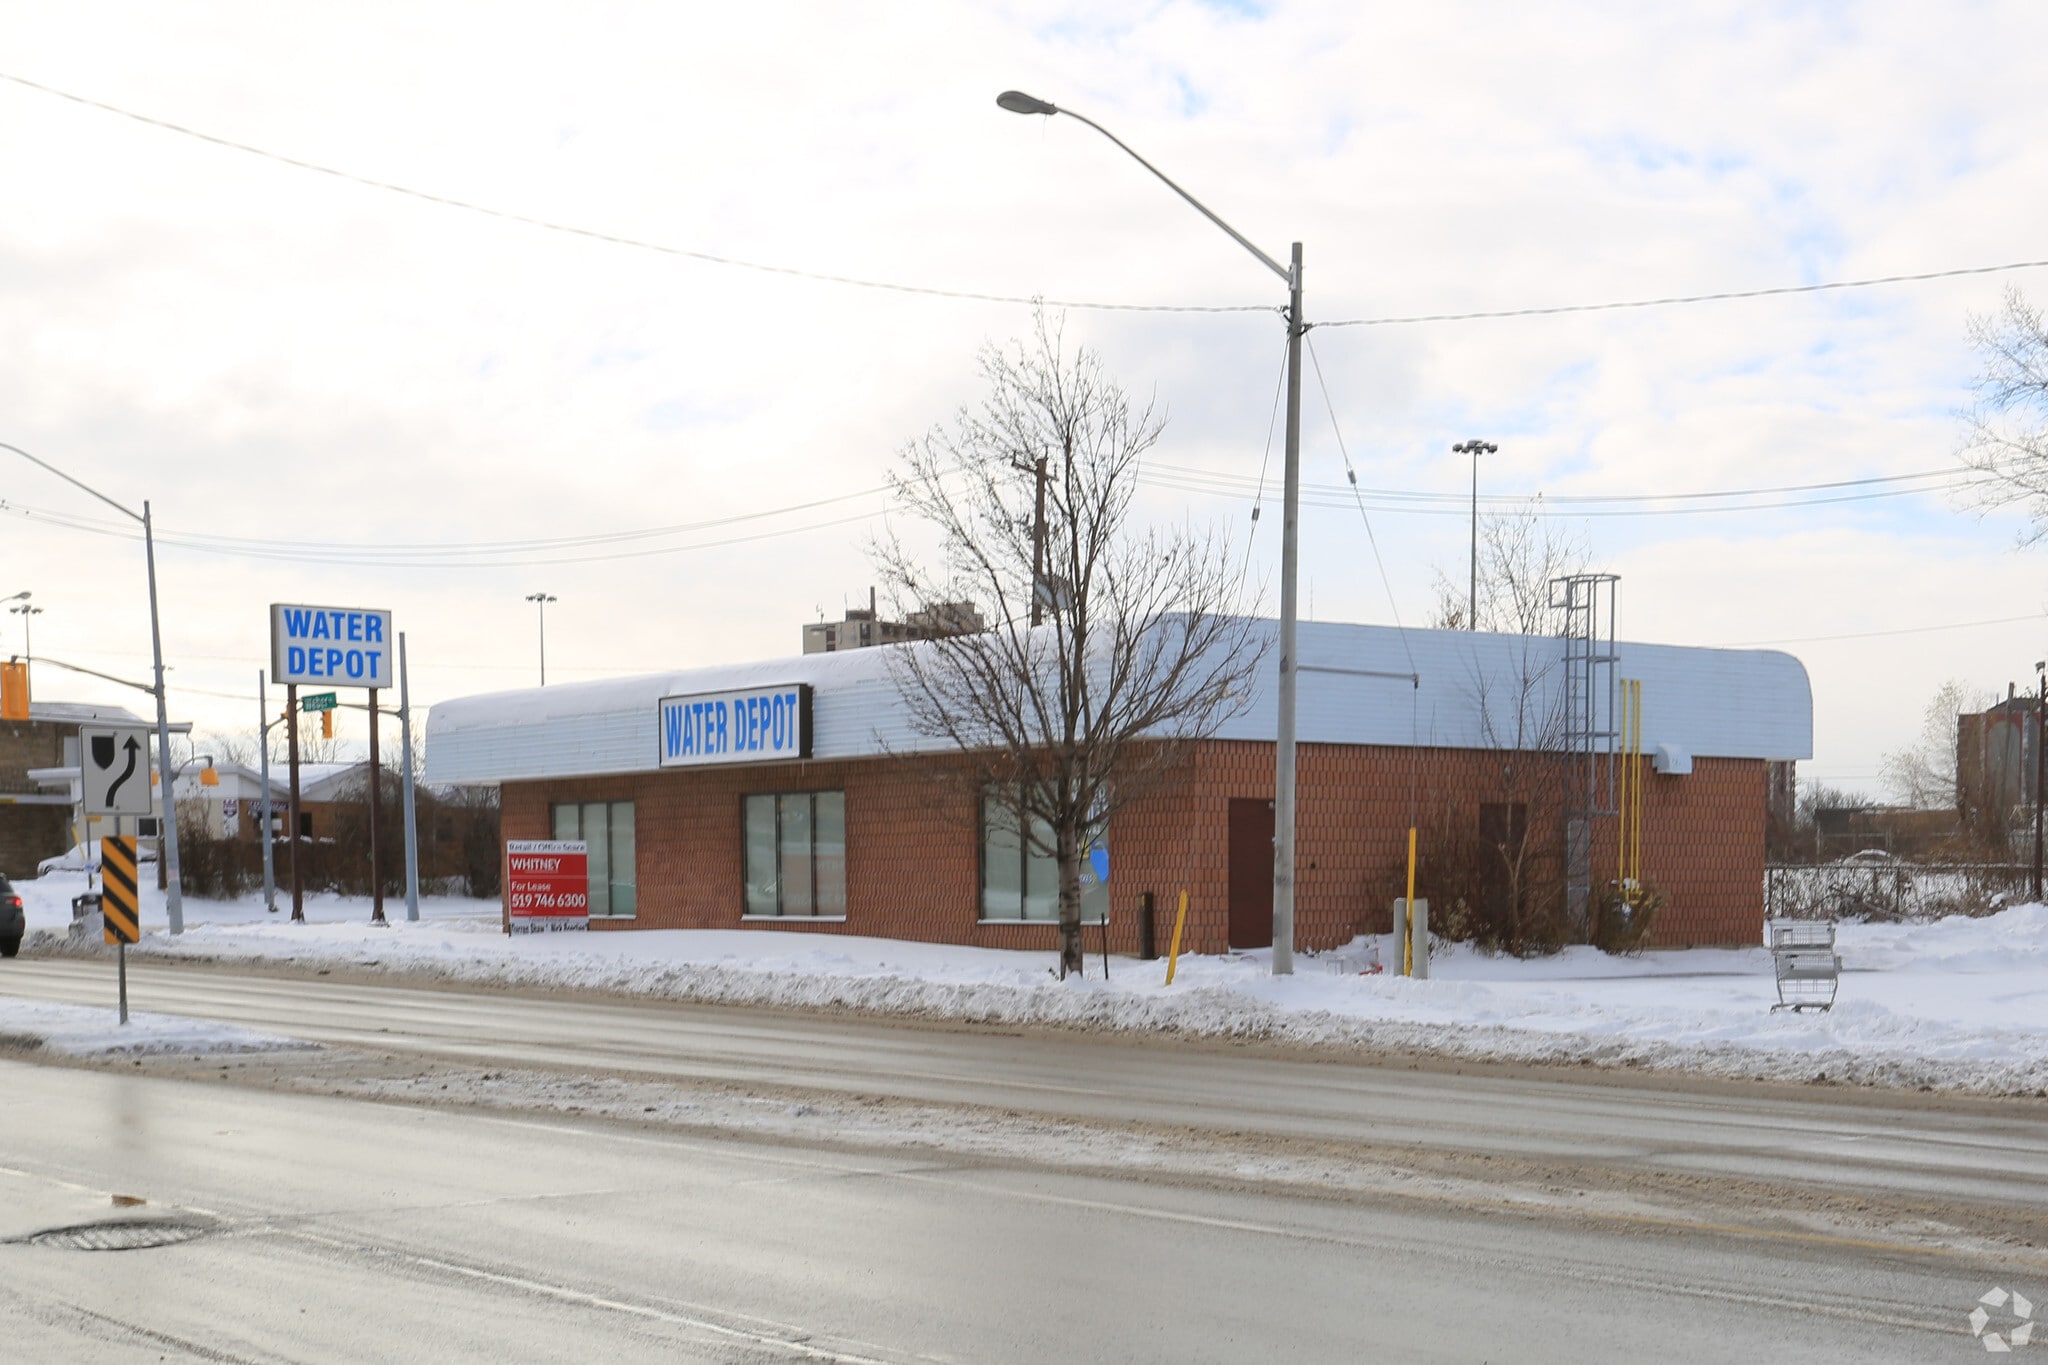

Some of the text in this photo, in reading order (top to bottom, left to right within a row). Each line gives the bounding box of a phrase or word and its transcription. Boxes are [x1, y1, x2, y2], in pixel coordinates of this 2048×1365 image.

[284, 608, 383, 643] WATER
[287, 646, 382, 680] DEPOT
[664, 692, 797, 758] WATER DEPOT
[511, 857, 561, 871] WHITNEY
[511, 881, 551, 891] For Lease
[512, 892, 586, 908] 519 746 6300
